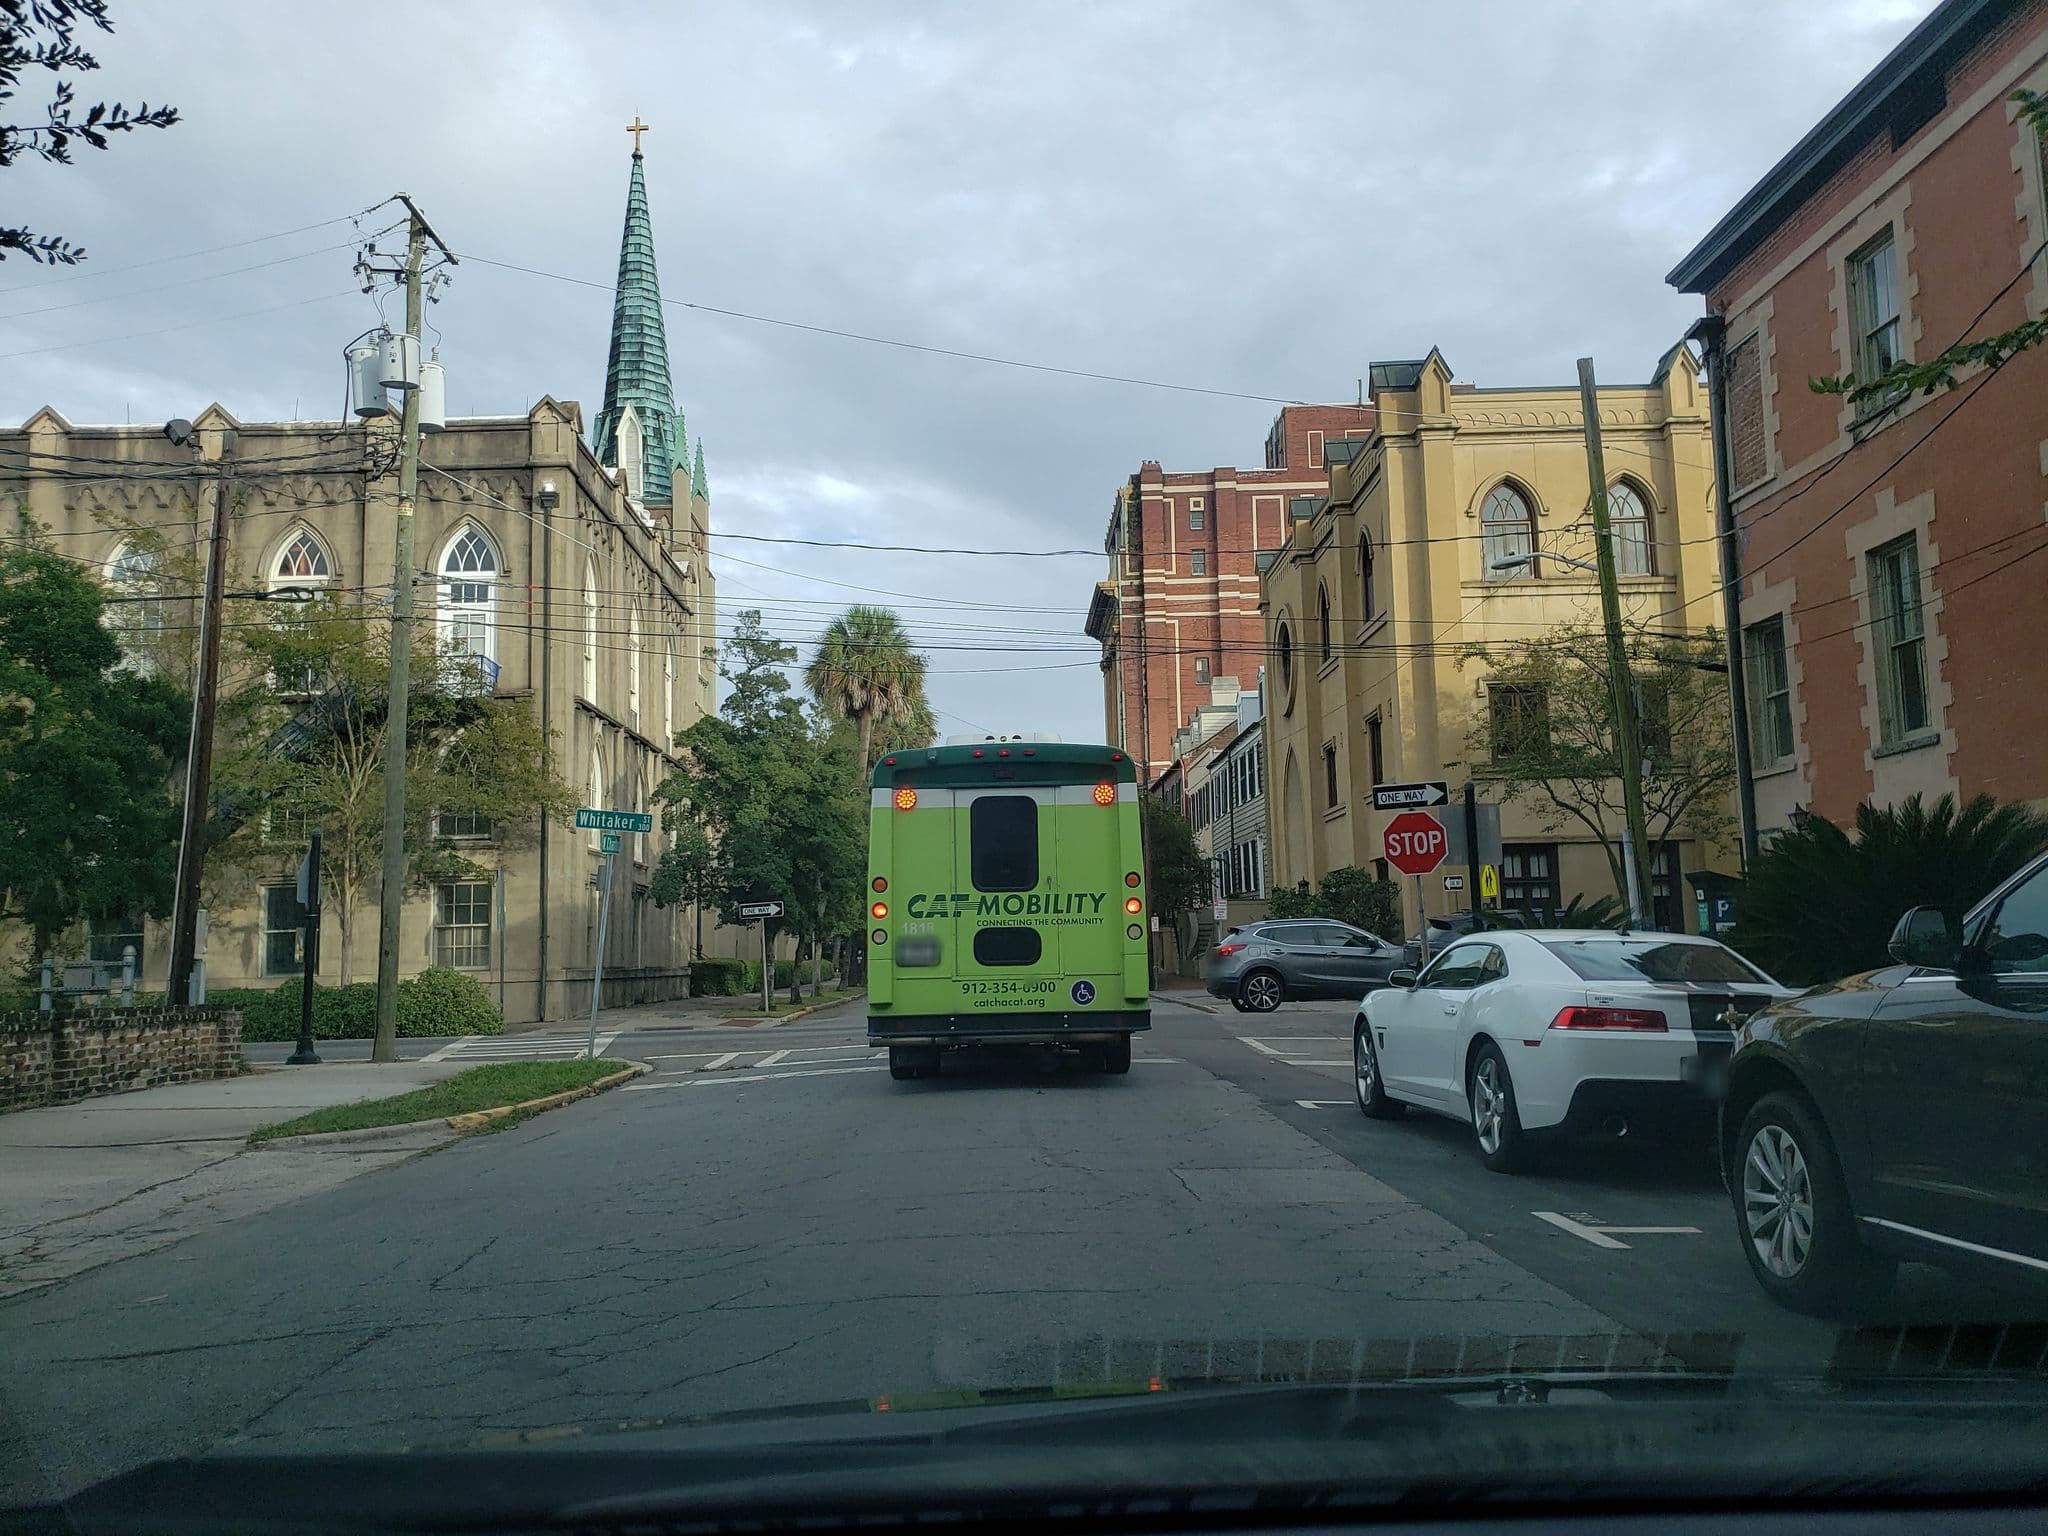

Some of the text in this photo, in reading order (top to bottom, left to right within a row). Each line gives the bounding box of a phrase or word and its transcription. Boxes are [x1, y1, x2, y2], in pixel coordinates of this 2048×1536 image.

[1380, 790, 1425, 803] ONE WAY
[580, 811, 635, 829] Whitaker
[637, 823, 650, 831] 300
[1388, 830, 1442, 857] STOP
[907, 892, 1107, 918] CAT MOBILITY
[1717, 900, 1730, 918] P
[976, 917, 1104, 927] CONNECTING THE COMMUNITY
[973, 997, 1045, 1008] catchacat.org
